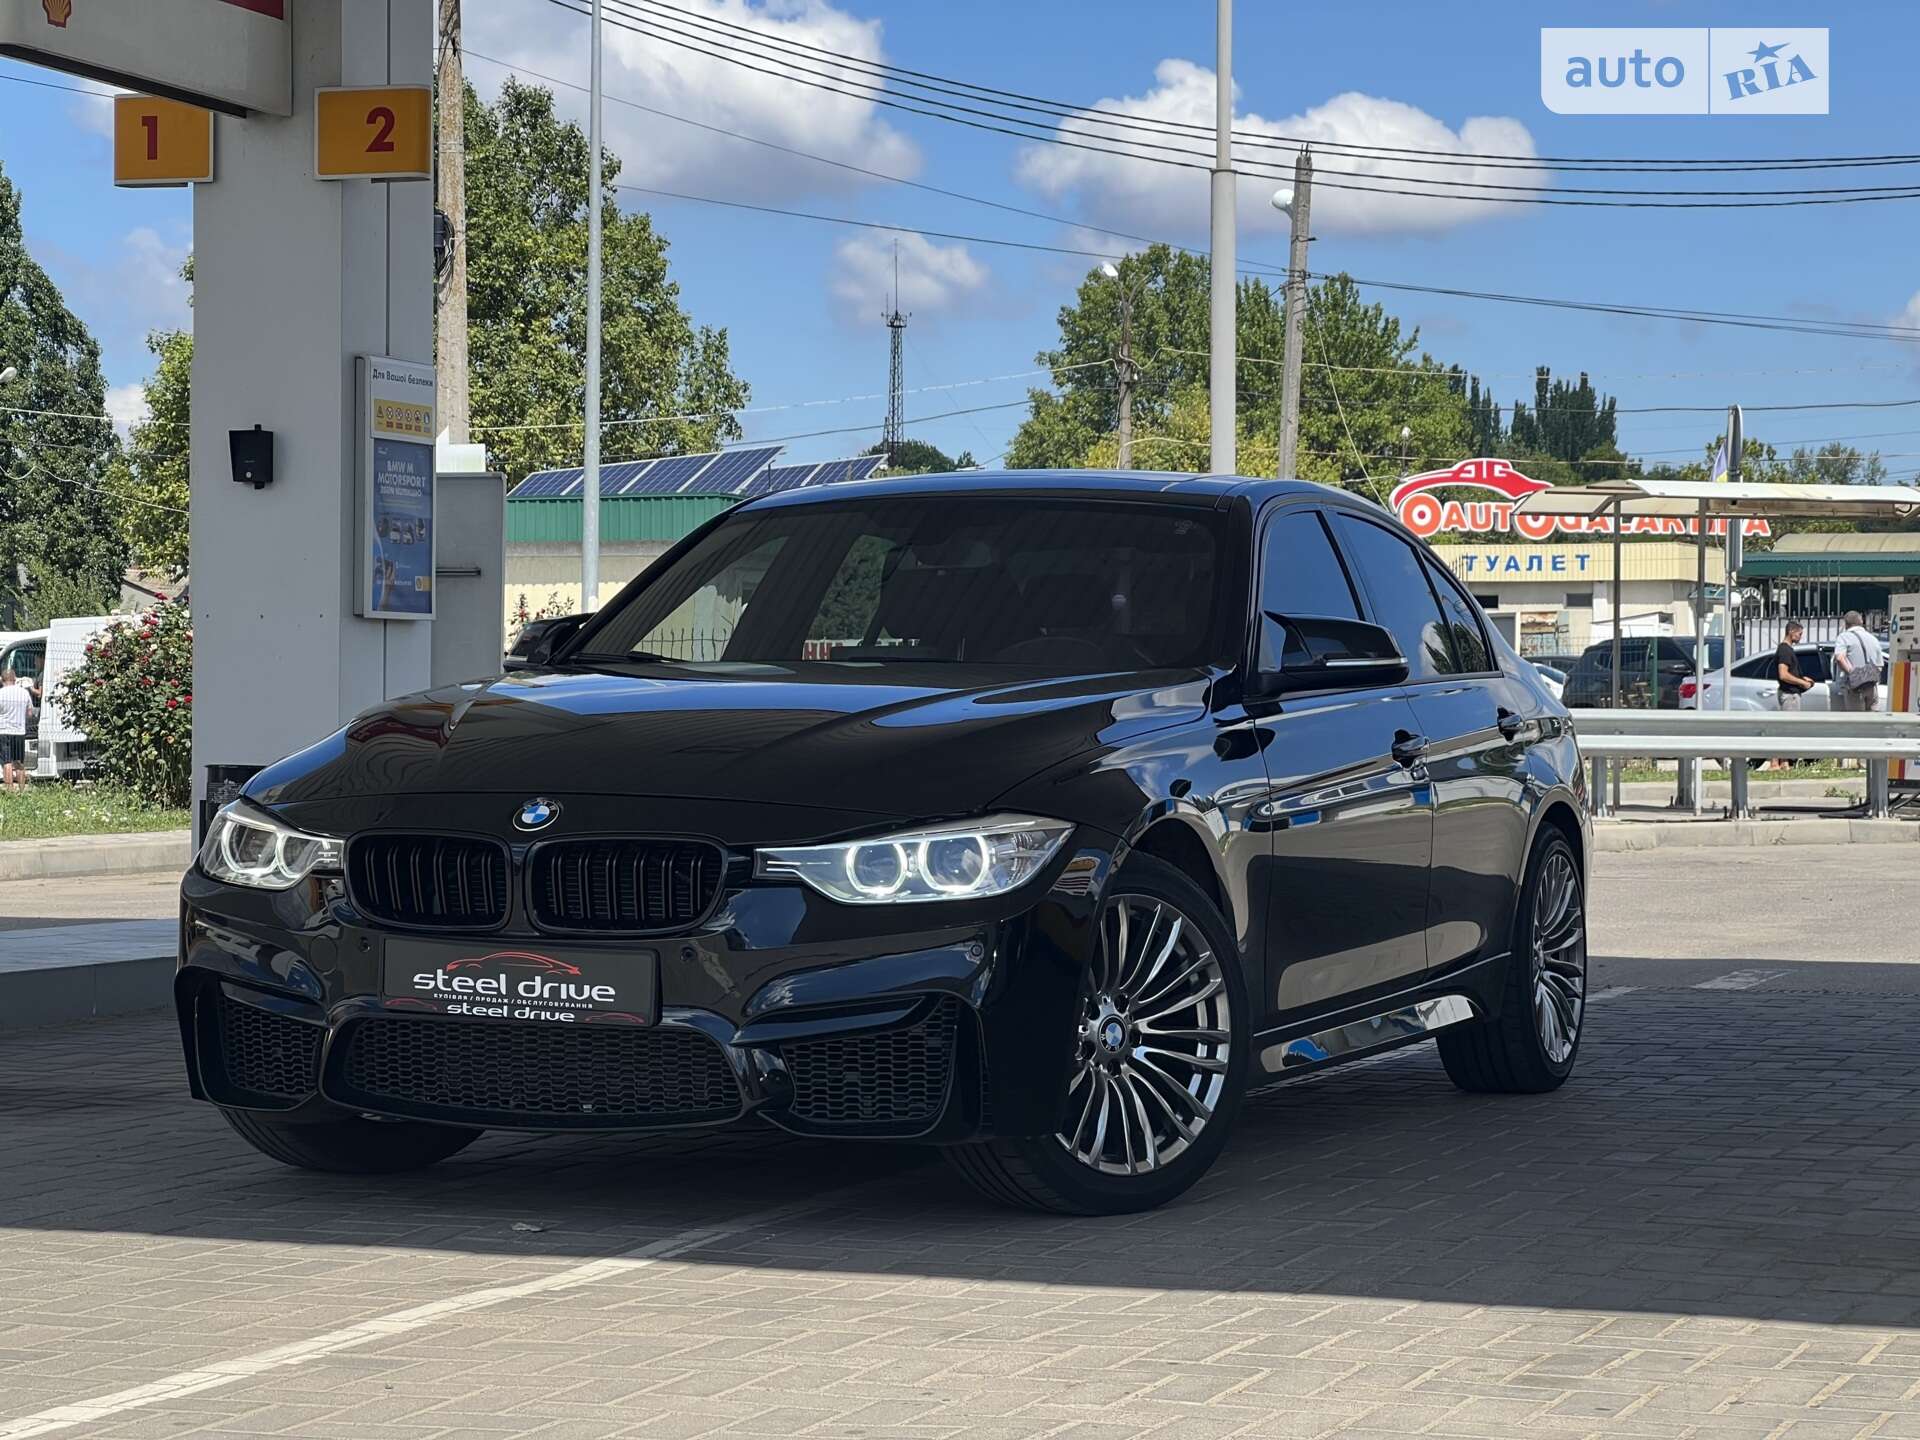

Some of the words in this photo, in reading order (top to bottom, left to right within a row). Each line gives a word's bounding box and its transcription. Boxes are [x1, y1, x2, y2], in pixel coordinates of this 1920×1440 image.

[141, 115, 158, 161] 1
[365, 106, 396, 153] 2
[372, 368, 385, 380] Для
[1464, 554, 1591, 572] ТУАЛЕТ
[1890, 614, 1899, 635] 6
[412, 968, 507, 996] steel
[517, 975, 616, 1002] drive
[446, 1002, 508, 1018] steel
[513, 1006, 576, 1023] drive
